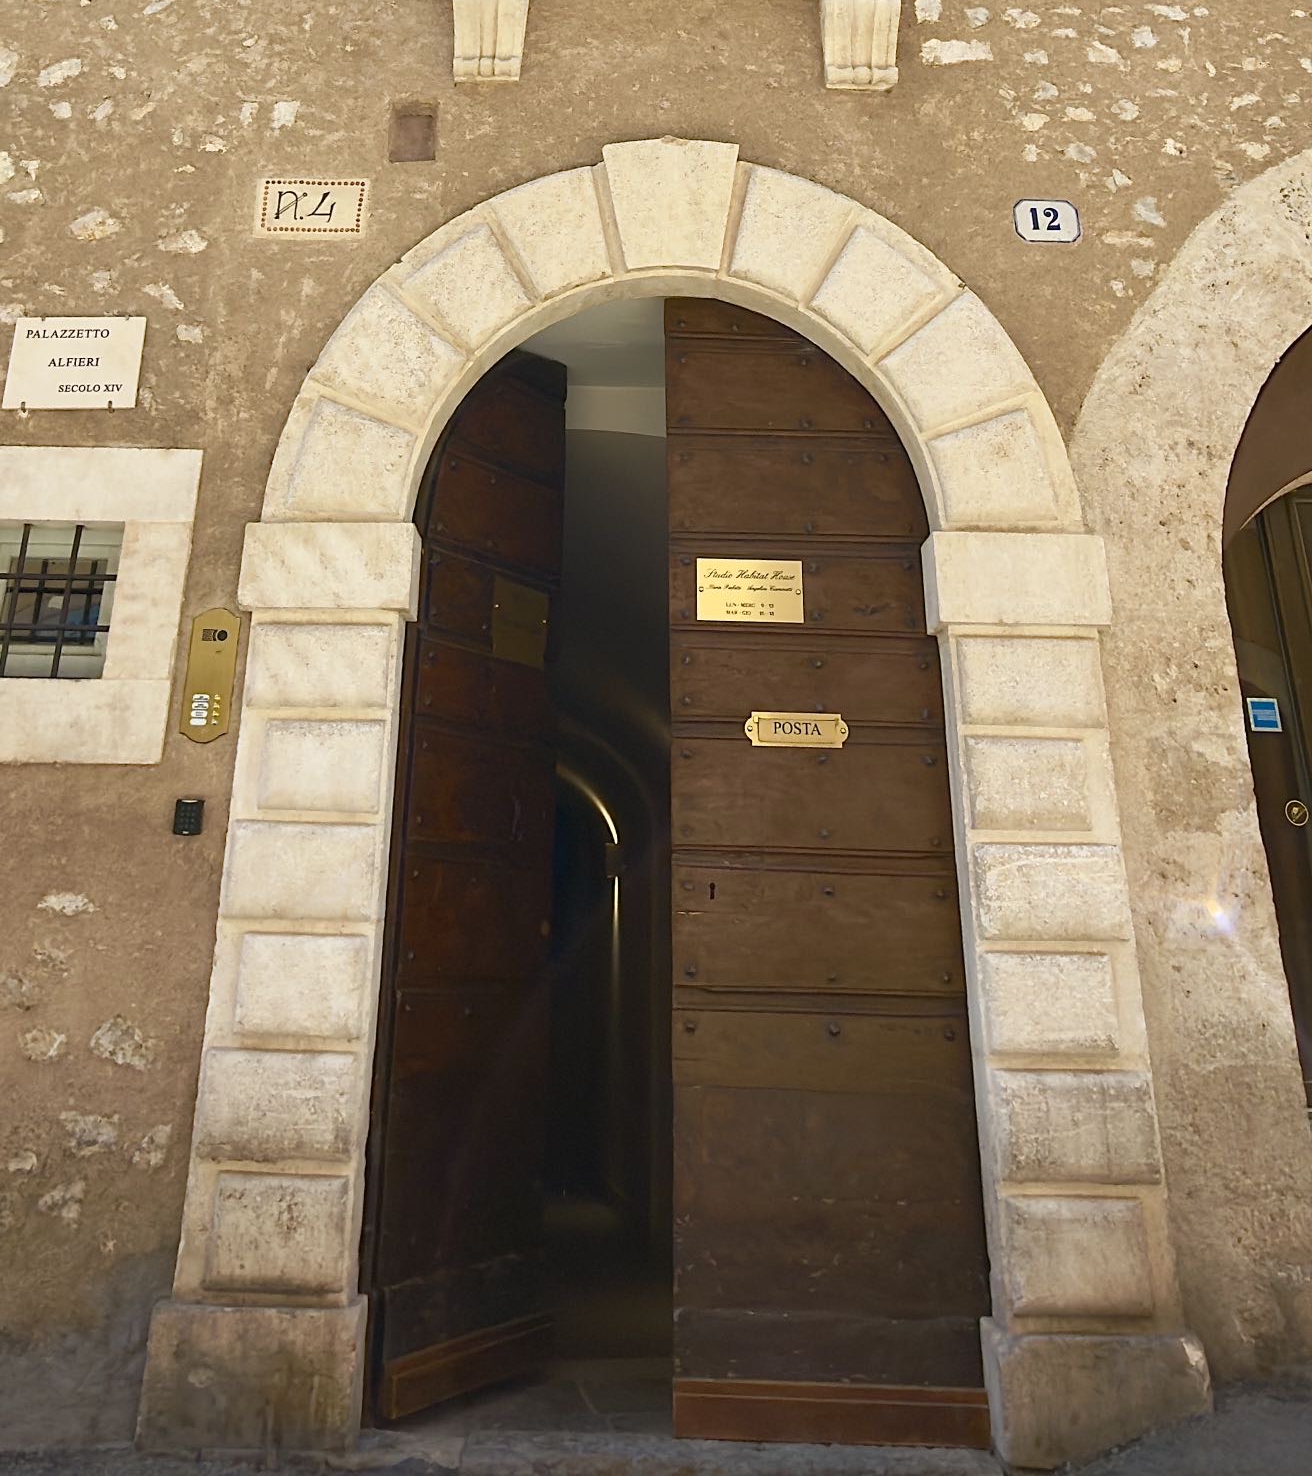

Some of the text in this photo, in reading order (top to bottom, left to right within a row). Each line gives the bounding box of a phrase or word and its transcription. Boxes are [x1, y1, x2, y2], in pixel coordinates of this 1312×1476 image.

[1030, 207, 1061, 230] 12
[26, 328, 110, 339] PALAZZETTO
[48, 357, 100, 367] ALFIERI
[58, 384, 123, 393] SECOLO XIV
[704, 568, 732, 578] Studio
[773, 722, 822, 736] POSTA
